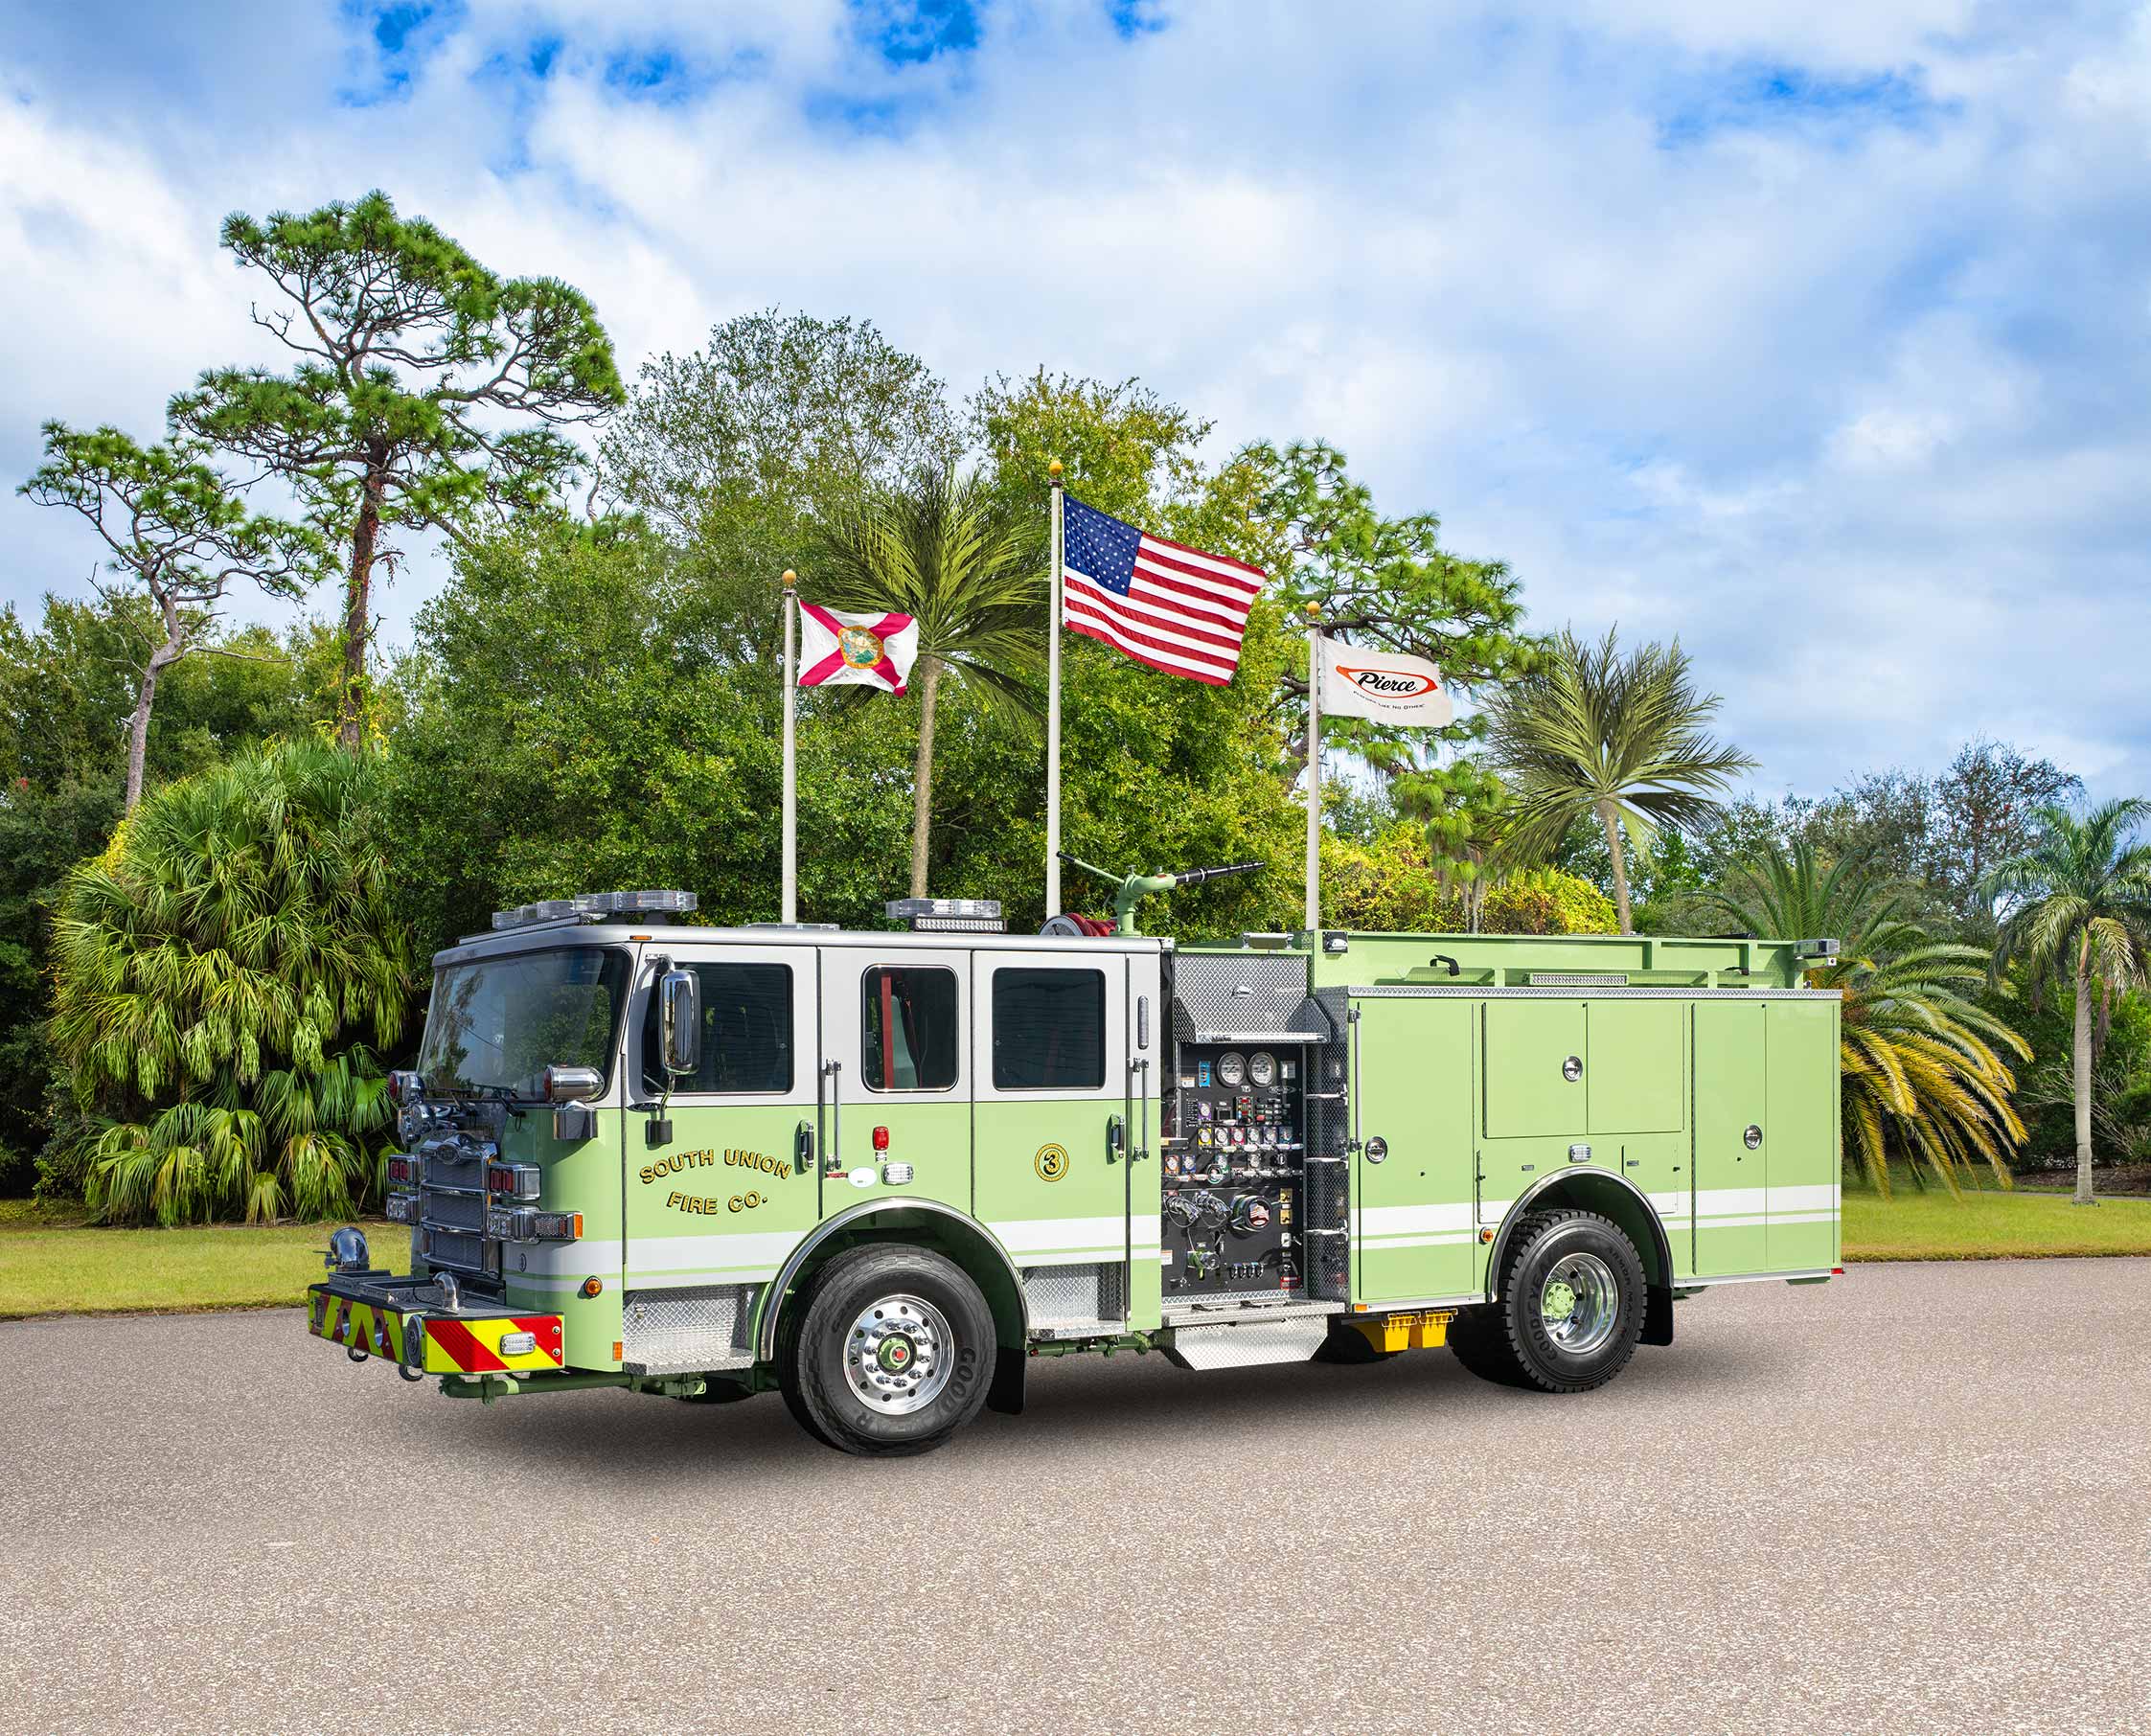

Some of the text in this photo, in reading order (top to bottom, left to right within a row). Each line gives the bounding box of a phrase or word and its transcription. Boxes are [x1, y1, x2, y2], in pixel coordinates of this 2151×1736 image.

[1358, 672, 1417, 692] Pierce
[639, 1149, 791, 1184] SOUTH UNION
[1043, 1150, 1061, 1175] 3
[666, 1191, 767, 1215] FIRE CO.
